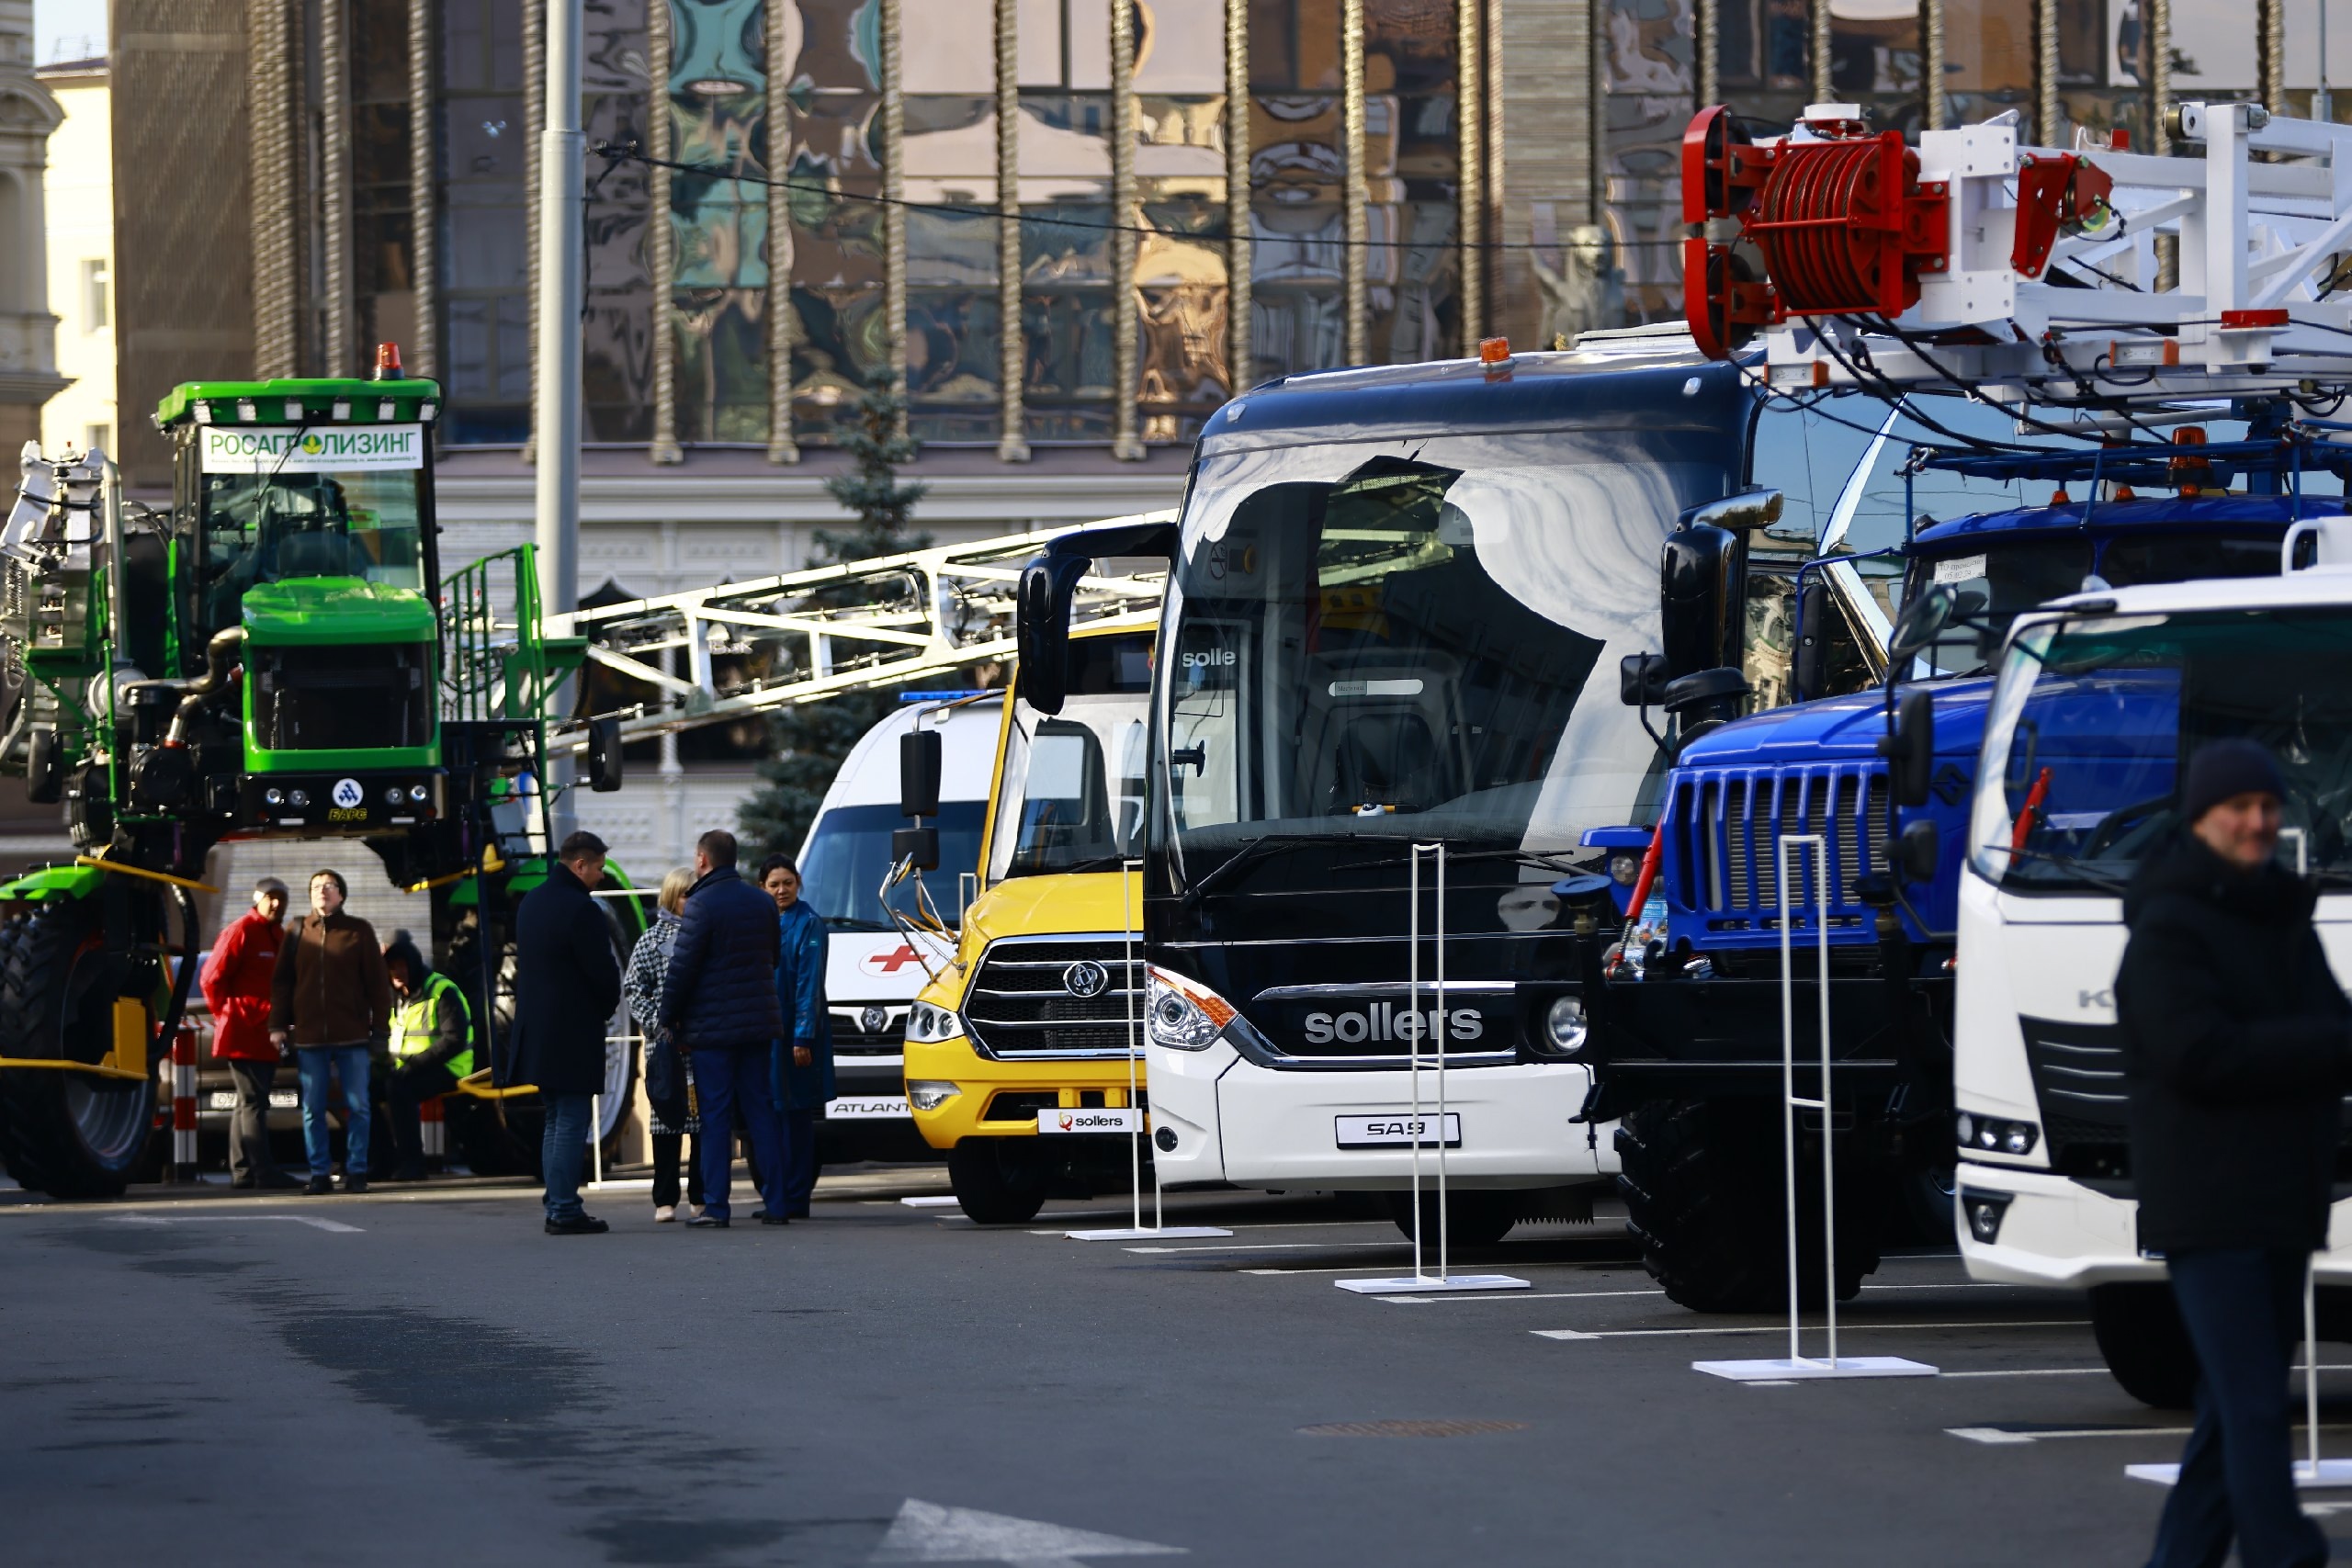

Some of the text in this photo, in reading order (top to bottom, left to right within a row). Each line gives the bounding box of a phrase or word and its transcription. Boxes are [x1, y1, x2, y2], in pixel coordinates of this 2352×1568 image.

[1182, 648, 1237, 668] solle
[328, 808, 368, 821] БАРС
[1305, 1001, 1484, 1043] sollers
[834, 1103, 909, 1112] ATLANT
[1076, 1115, 1124, 1126] sollers
[1367, 1122, 1426, 1135] SA9
